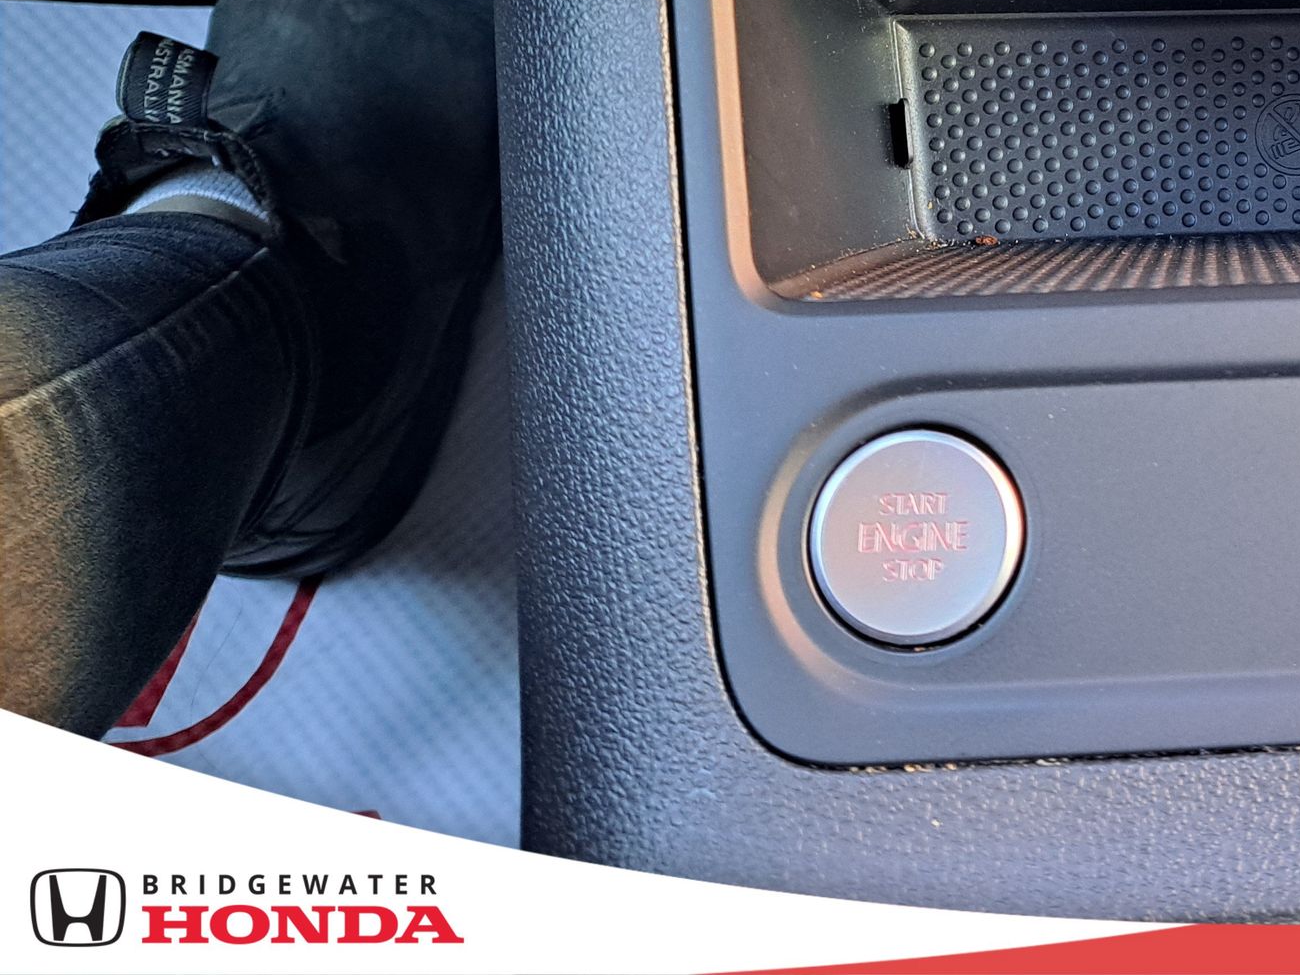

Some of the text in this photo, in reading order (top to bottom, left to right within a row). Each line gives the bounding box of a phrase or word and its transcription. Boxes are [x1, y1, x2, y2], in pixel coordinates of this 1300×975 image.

[879, 492, 948, 515] START
[858, 521, 969, 554] ENGINE
[882, 558, 944, 582] STOP
